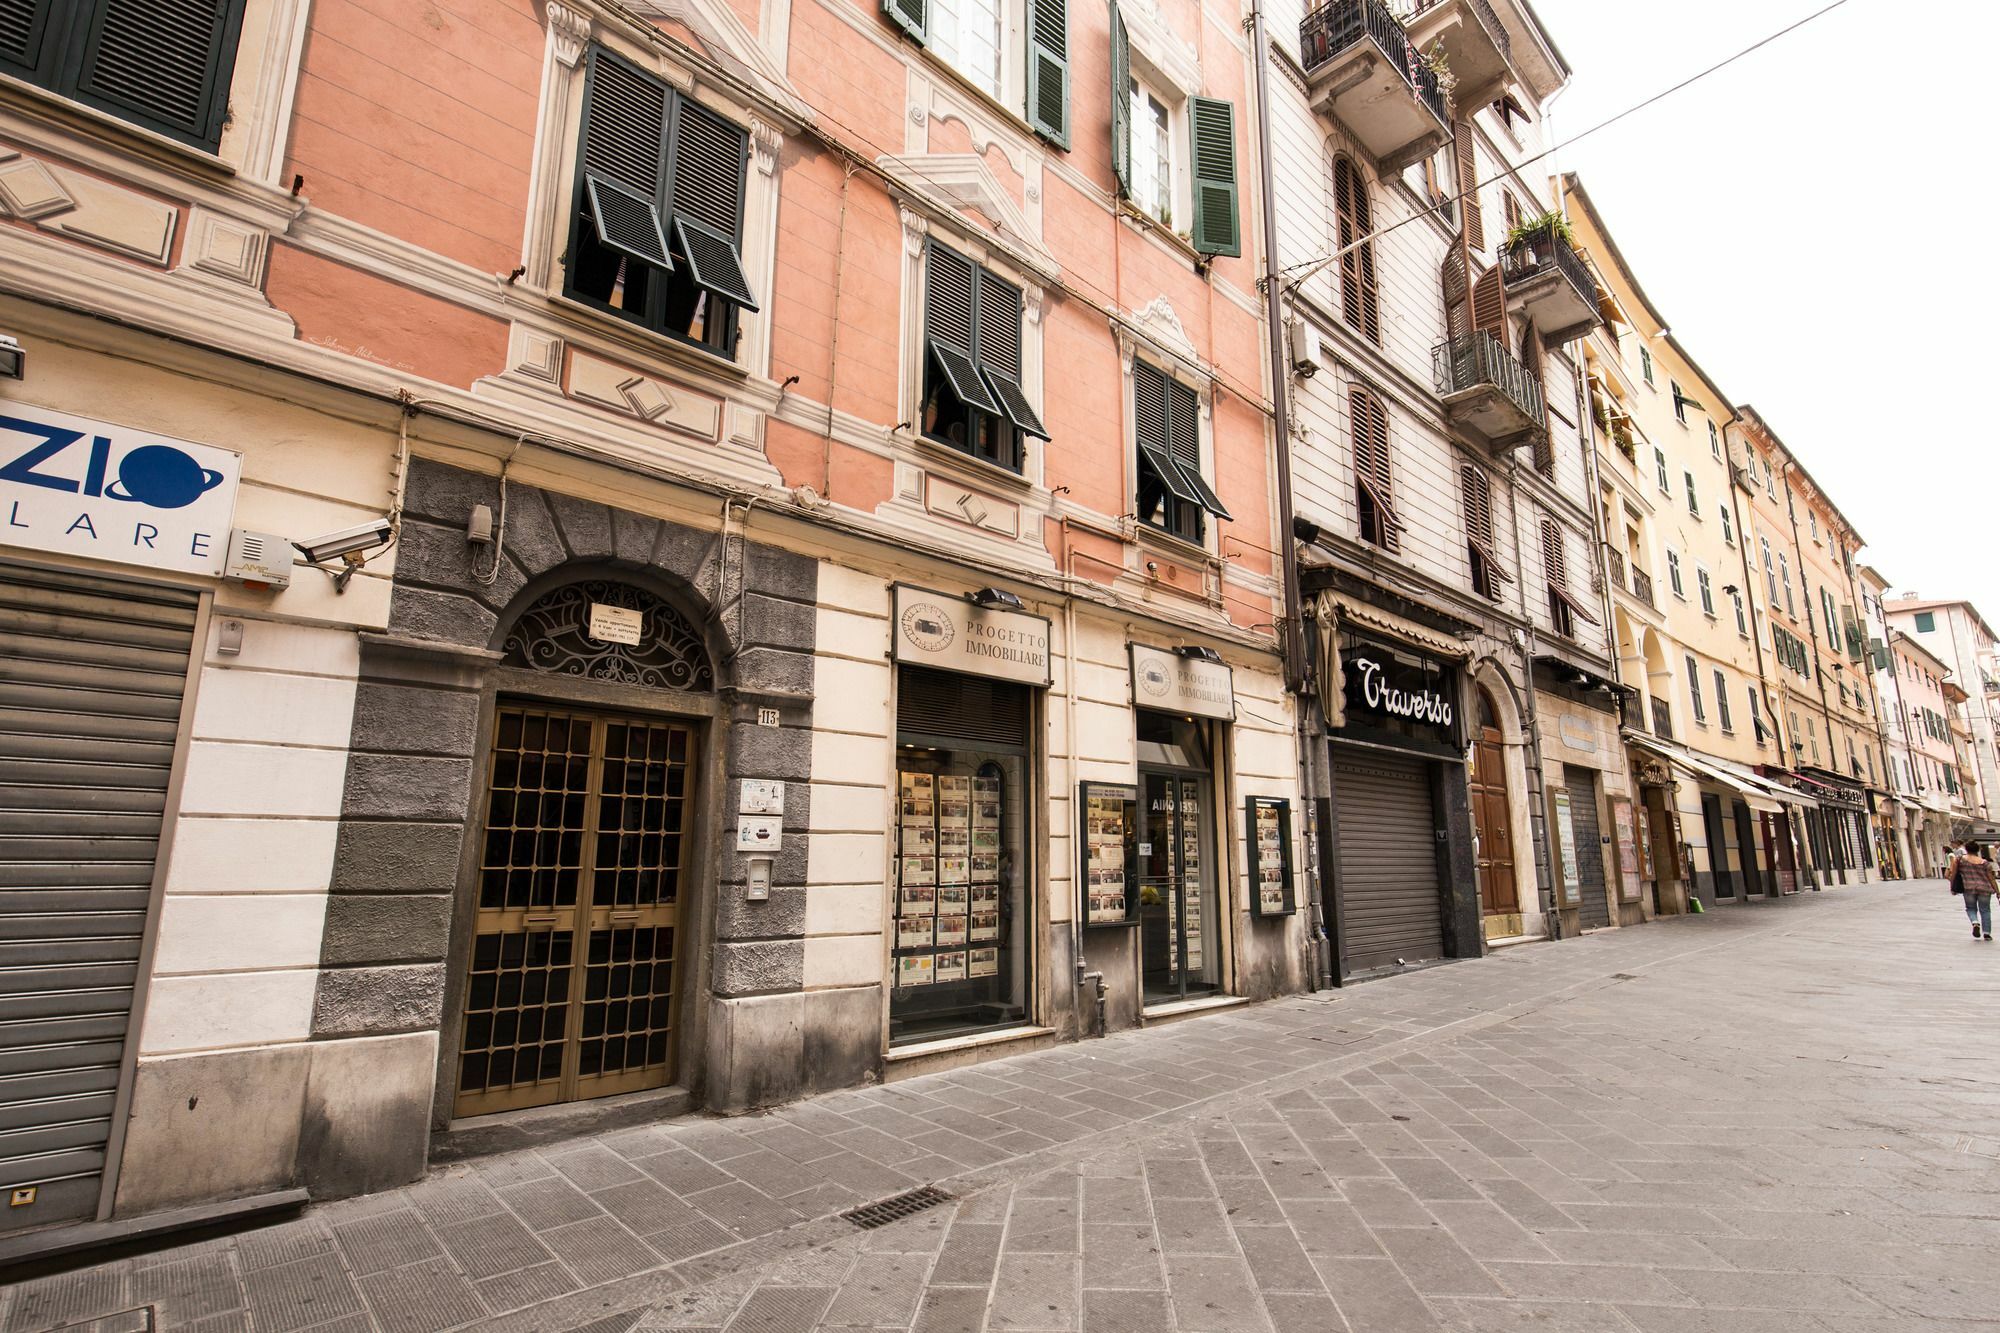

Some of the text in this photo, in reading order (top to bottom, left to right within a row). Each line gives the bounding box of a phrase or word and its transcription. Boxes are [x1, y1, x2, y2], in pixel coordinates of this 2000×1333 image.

[967, 621, 1046, 648] PROGETTO
[966, 640, 1046, 667] IMMOBILIARE
[1177, 671, 1230, 689] PROGETTO
[1357, 657, 1452, 726] Traverso
[1178, 686, 1230, 705] IMMOBILIARE
[762, 710, 776, 724] 113
